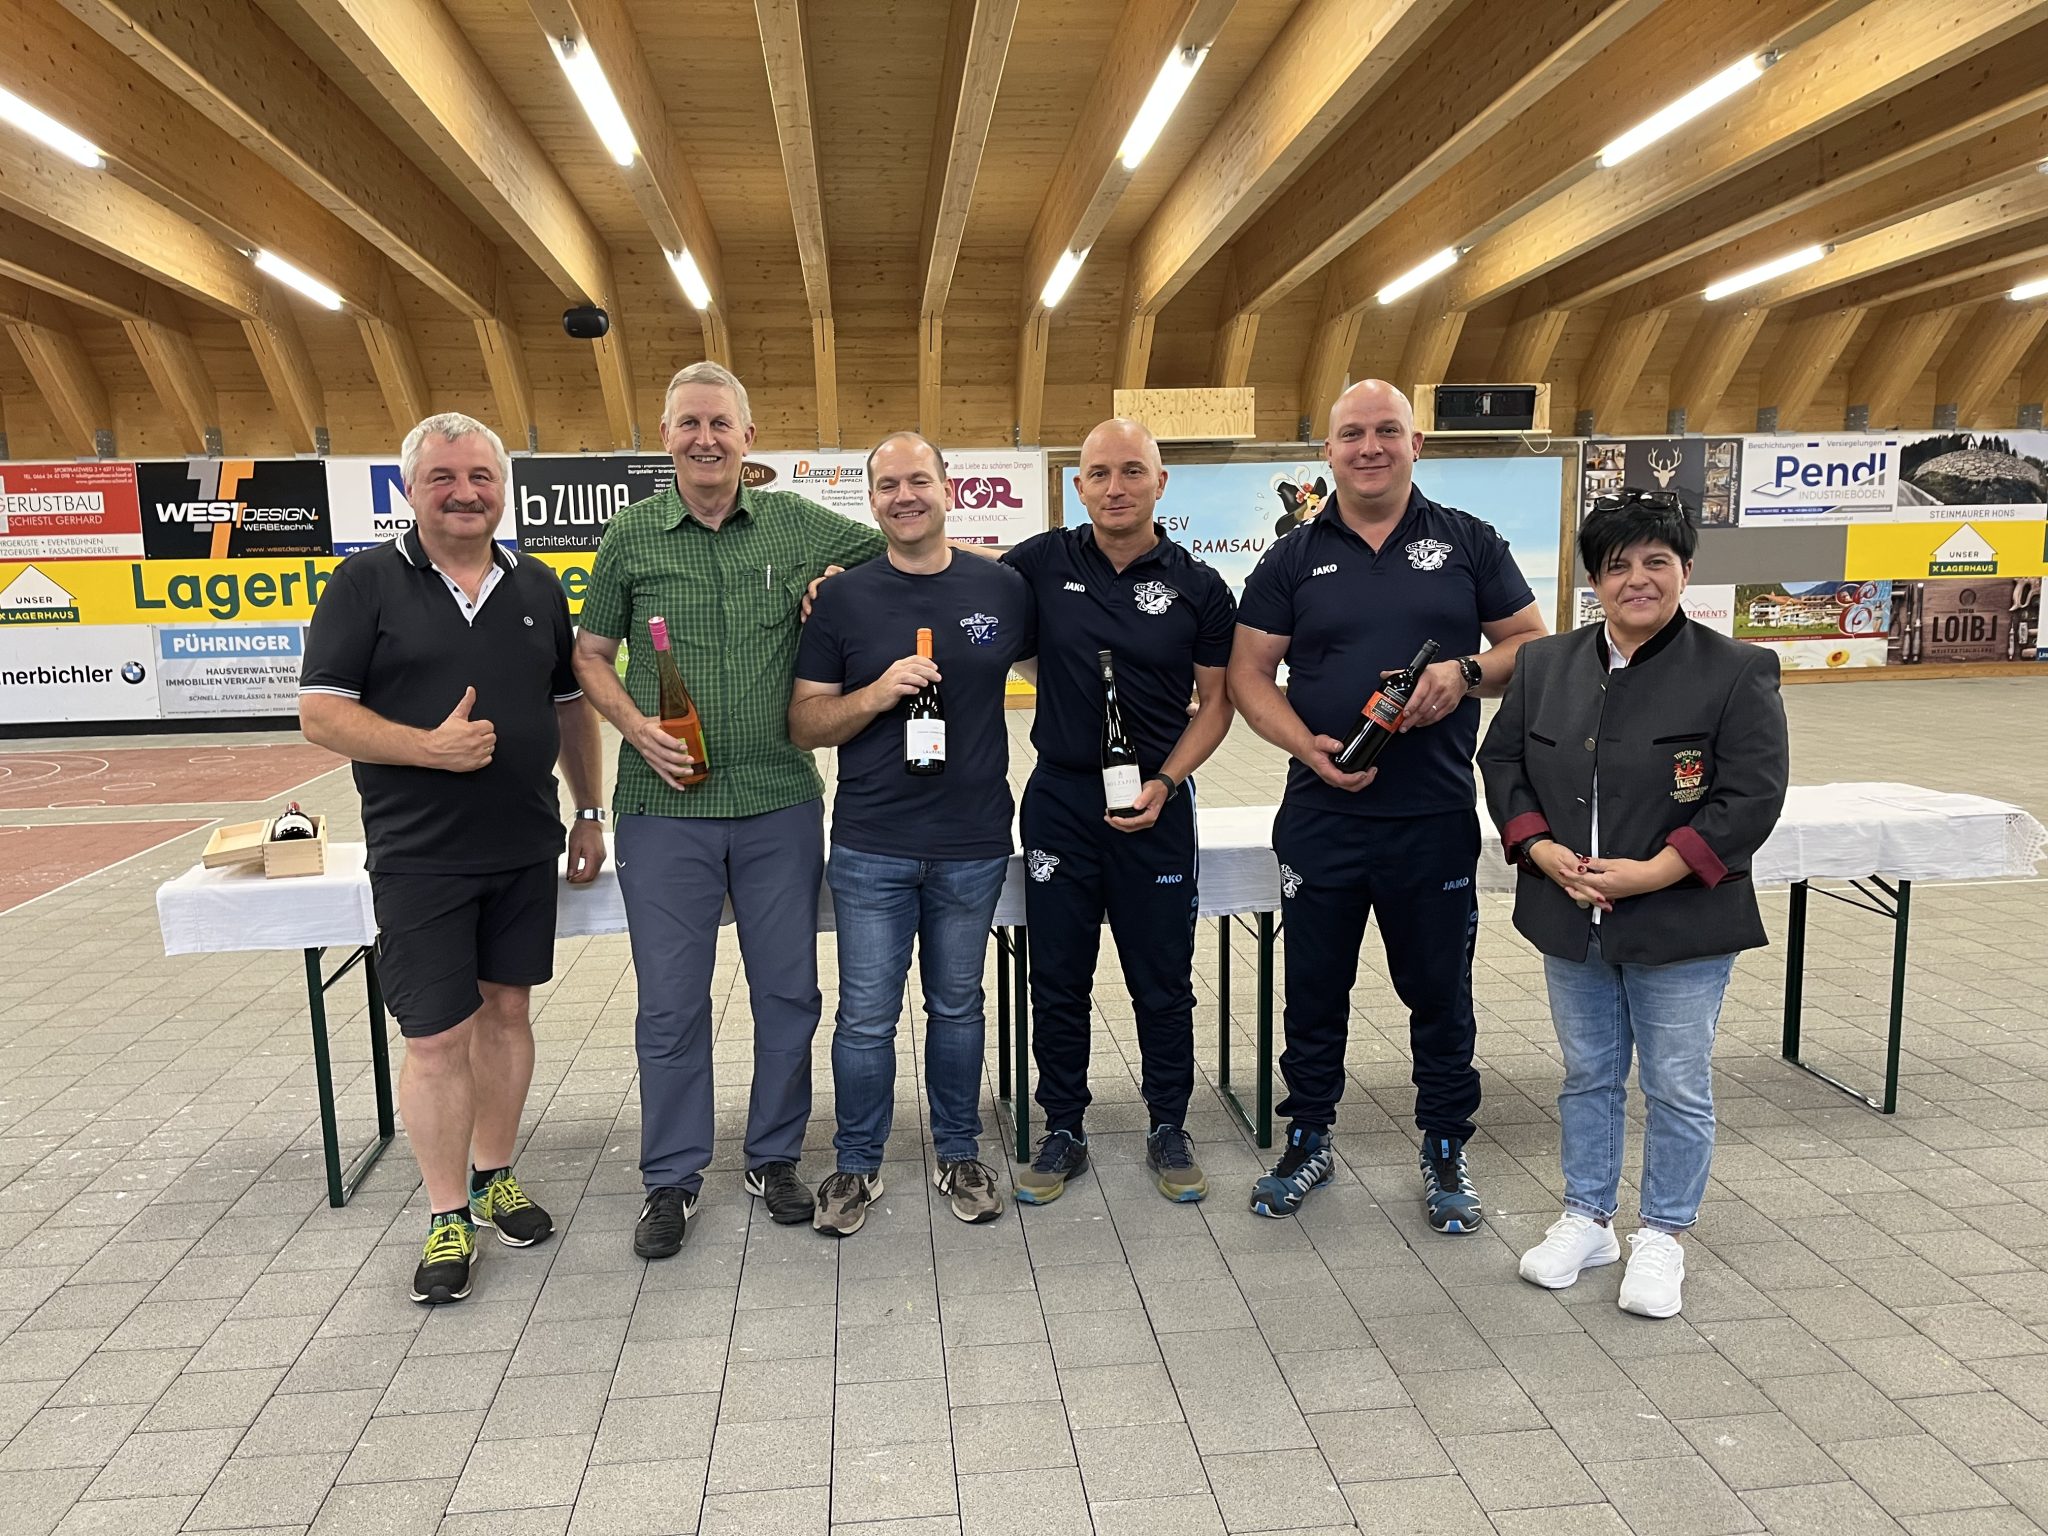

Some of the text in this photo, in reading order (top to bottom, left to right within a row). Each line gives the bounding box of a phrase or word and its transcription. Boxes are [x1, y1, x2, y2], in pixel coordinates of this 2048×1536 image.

[1748, 442, 1804, 450] Beschichtungen
[1827, 440, 1882, 448] Versiegelungen
[1014, 462, 1033, 470] Dingen
[1775, 452, 1886, 488] Pendl
[1800, 488, 1885, 500] INDUSTRIEBÖDEN
[1930, 509, 2015, 519] STEINMAURER HONS
[9, 515, 103, 527] SCHIESTL GERHARD
[244, 523, 314, 531] WERBEtechnik
[48, 538, 103, 546] EVENTBÜHNEN
[1192, 538, 1264, 553] RAMSAU
[49, 546, 119, 555] FASSADENGERÜSTE
[1312, 564, 1338, 577] JAKO
[1064, 582, 1085, 593] JAKO
[9, 611, 74, 620] LAGERHAUS
[1684, 610, 1728, 618] TEMENTS
[173, 634, 291, 653] PÜHRINGER
[0, 666, 113, 685] nerbichler
[206, 666, 296, 676] HAUSVERWALTUNG
[224, 677, 266, 685] VERKAUF
[1155, 874, 1182, 884] JAKO
[1443, 877, 1469, 891] JAKO
